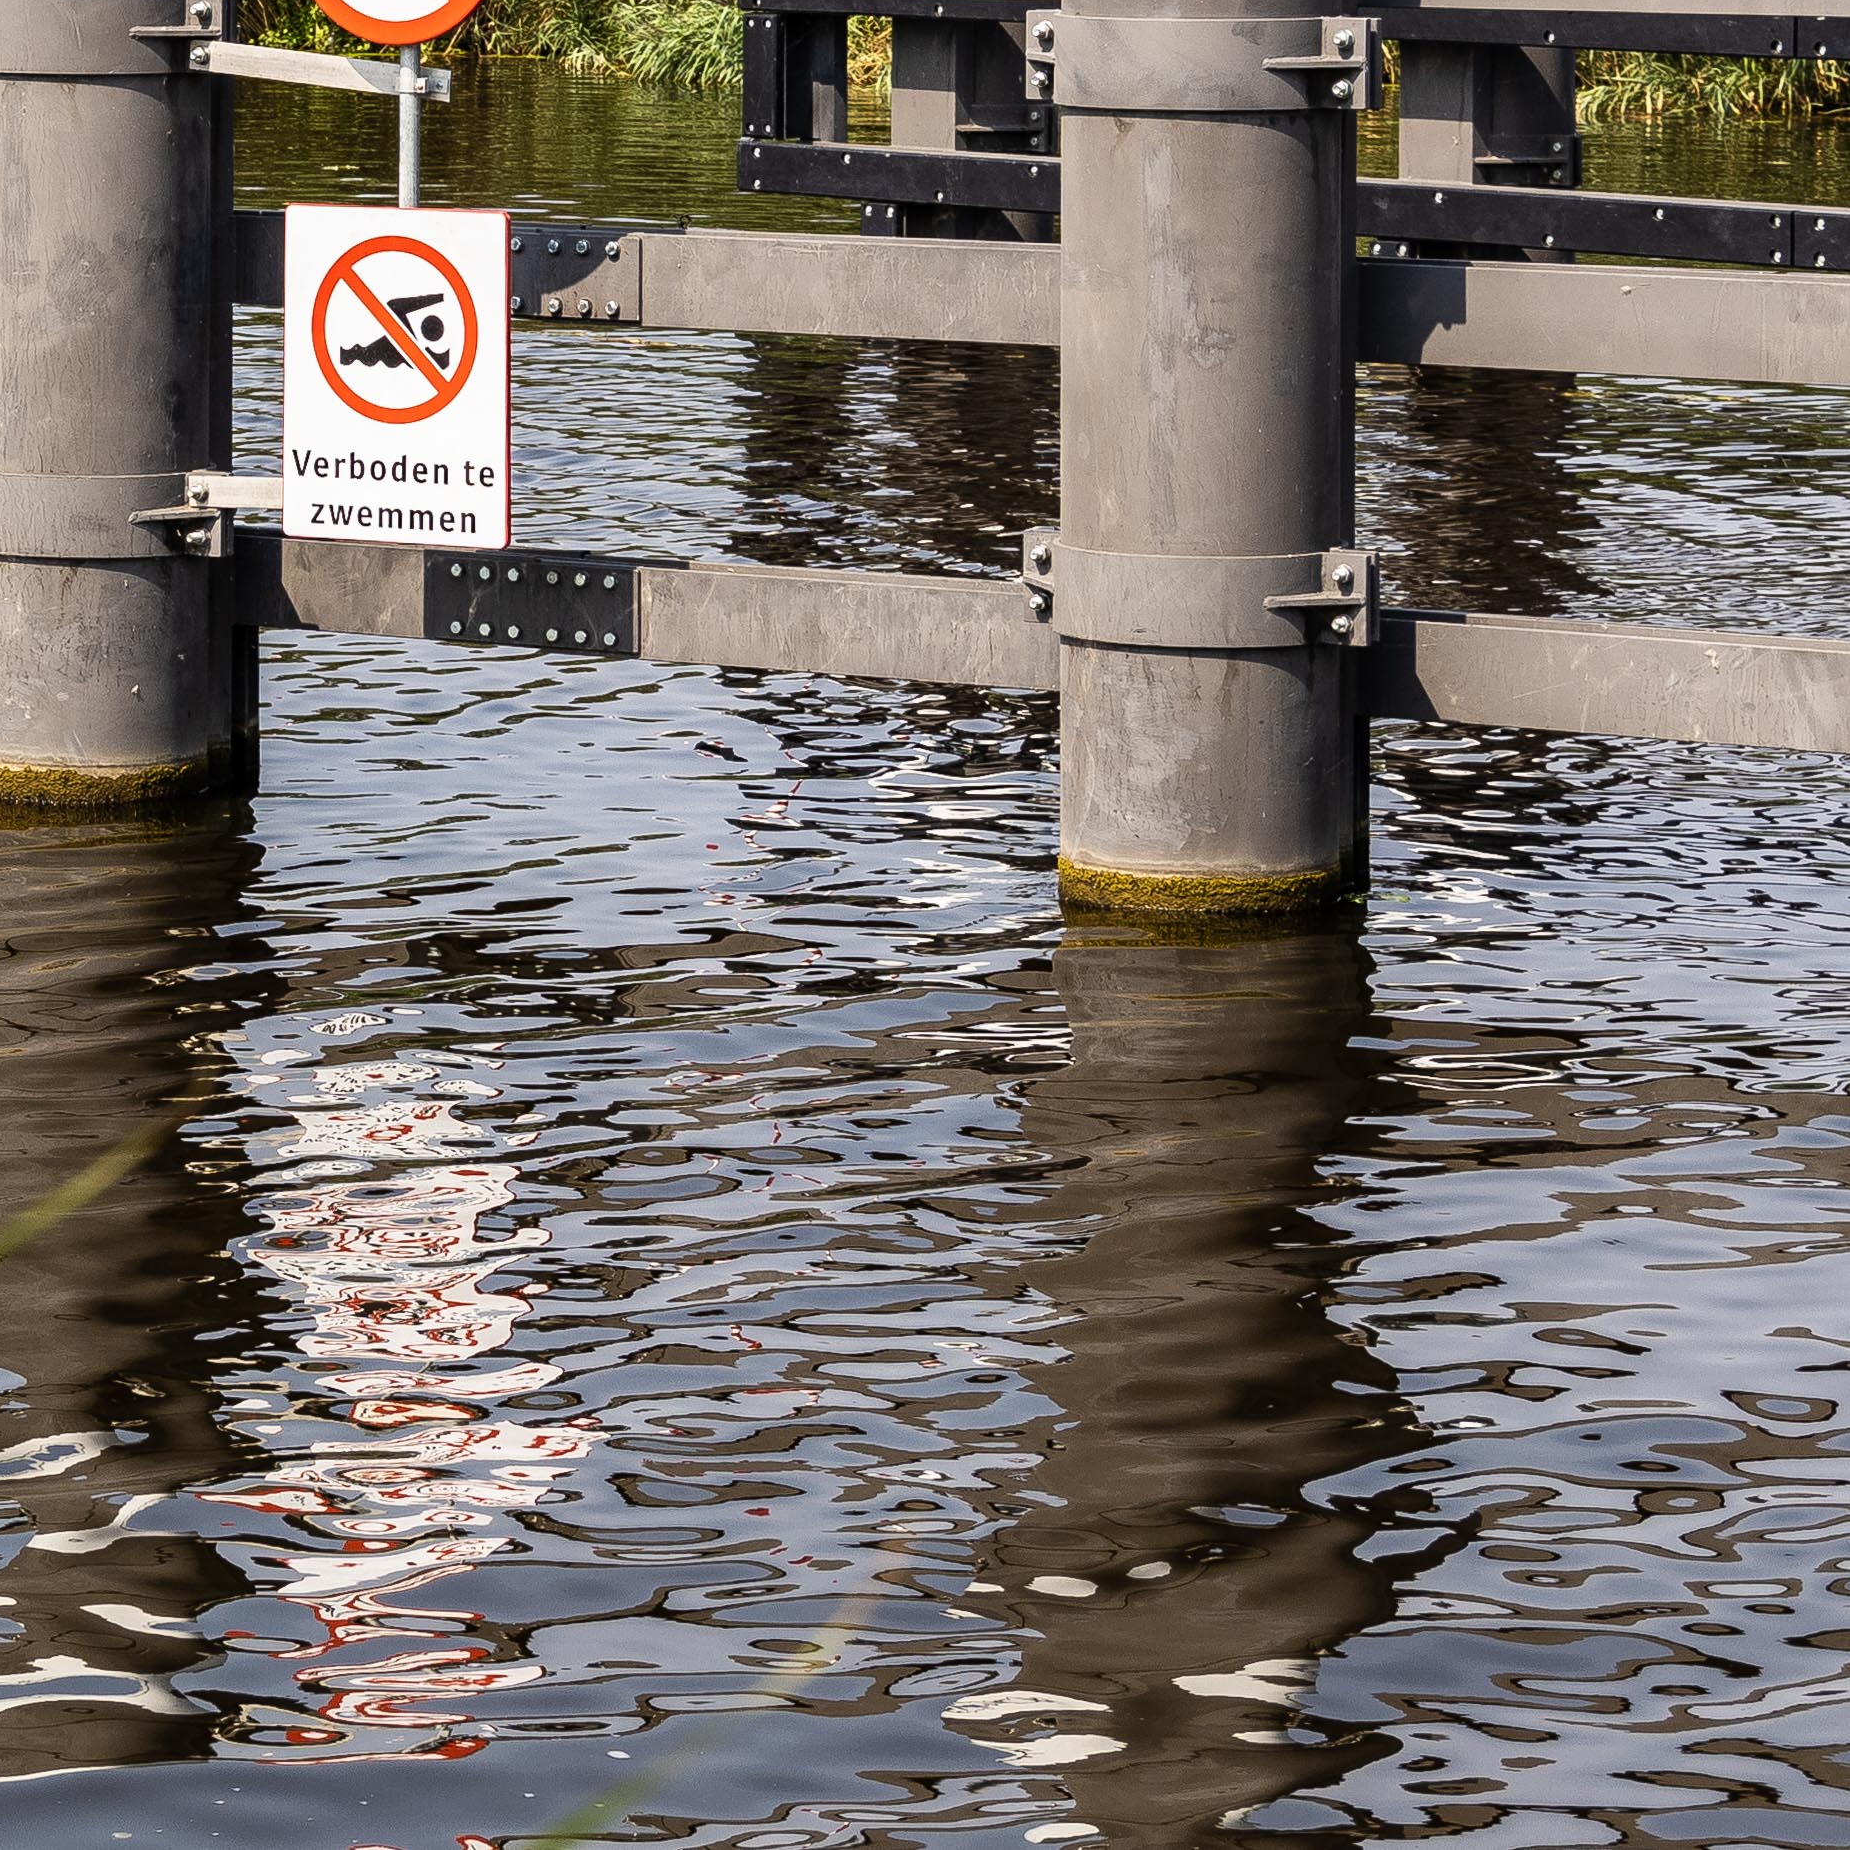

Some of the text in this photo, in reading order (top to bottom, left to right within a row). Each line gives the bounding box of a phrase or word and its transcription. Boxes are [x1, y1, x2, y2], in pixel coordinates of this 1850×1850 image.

[292, 449, 495, 487] Verboden te
[311, 503, 477, 534] zwemmen
